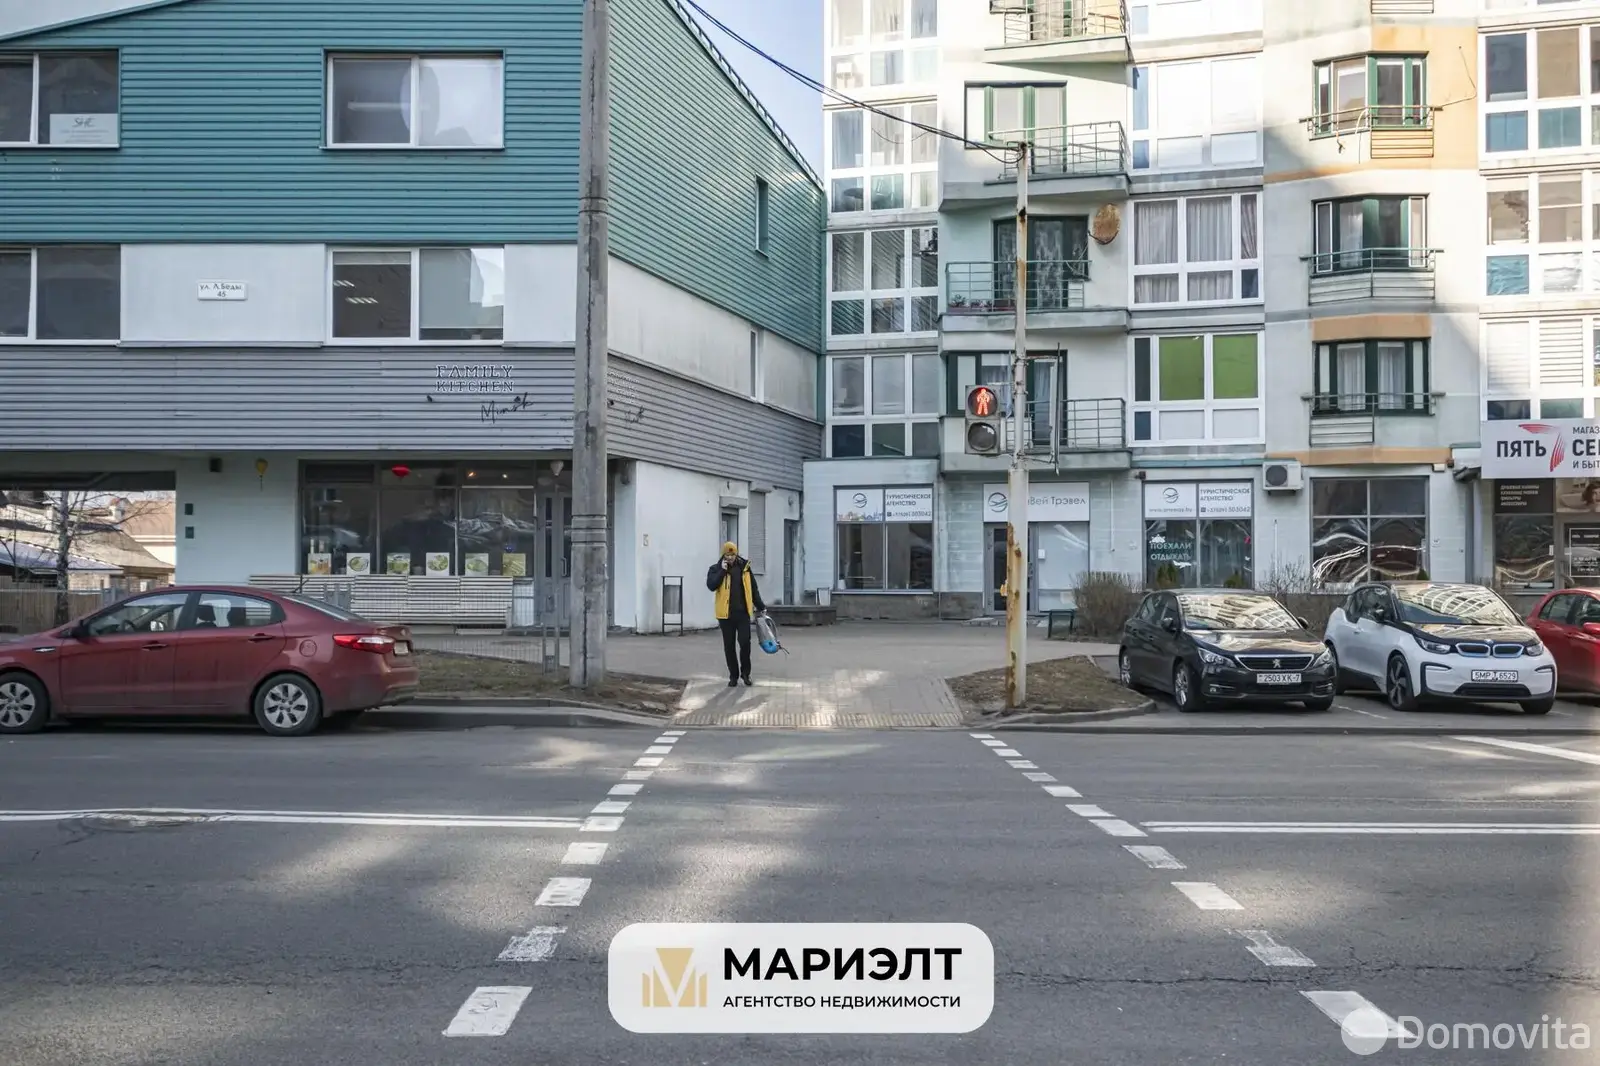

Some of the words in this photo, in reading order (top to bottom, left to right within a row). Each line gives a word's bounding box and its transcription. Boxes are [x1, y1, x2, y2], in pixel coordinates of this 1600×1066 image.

[435, 364, 514, 378] FAMILY
[435, 379, 515, 393] KITCHEN
[1496, 440, 1547, 458] ПЯТЬ
[1572, 438, 1600, 457] СЕ
[1572, 460, 1579, 469] И
[1051, 496, 1086, 507] Трэвел
[1150, 542, 1192, 550] ПОЕХАЛИ
[1150, 553, 1192, 561] ОТДЫХАТЬ
